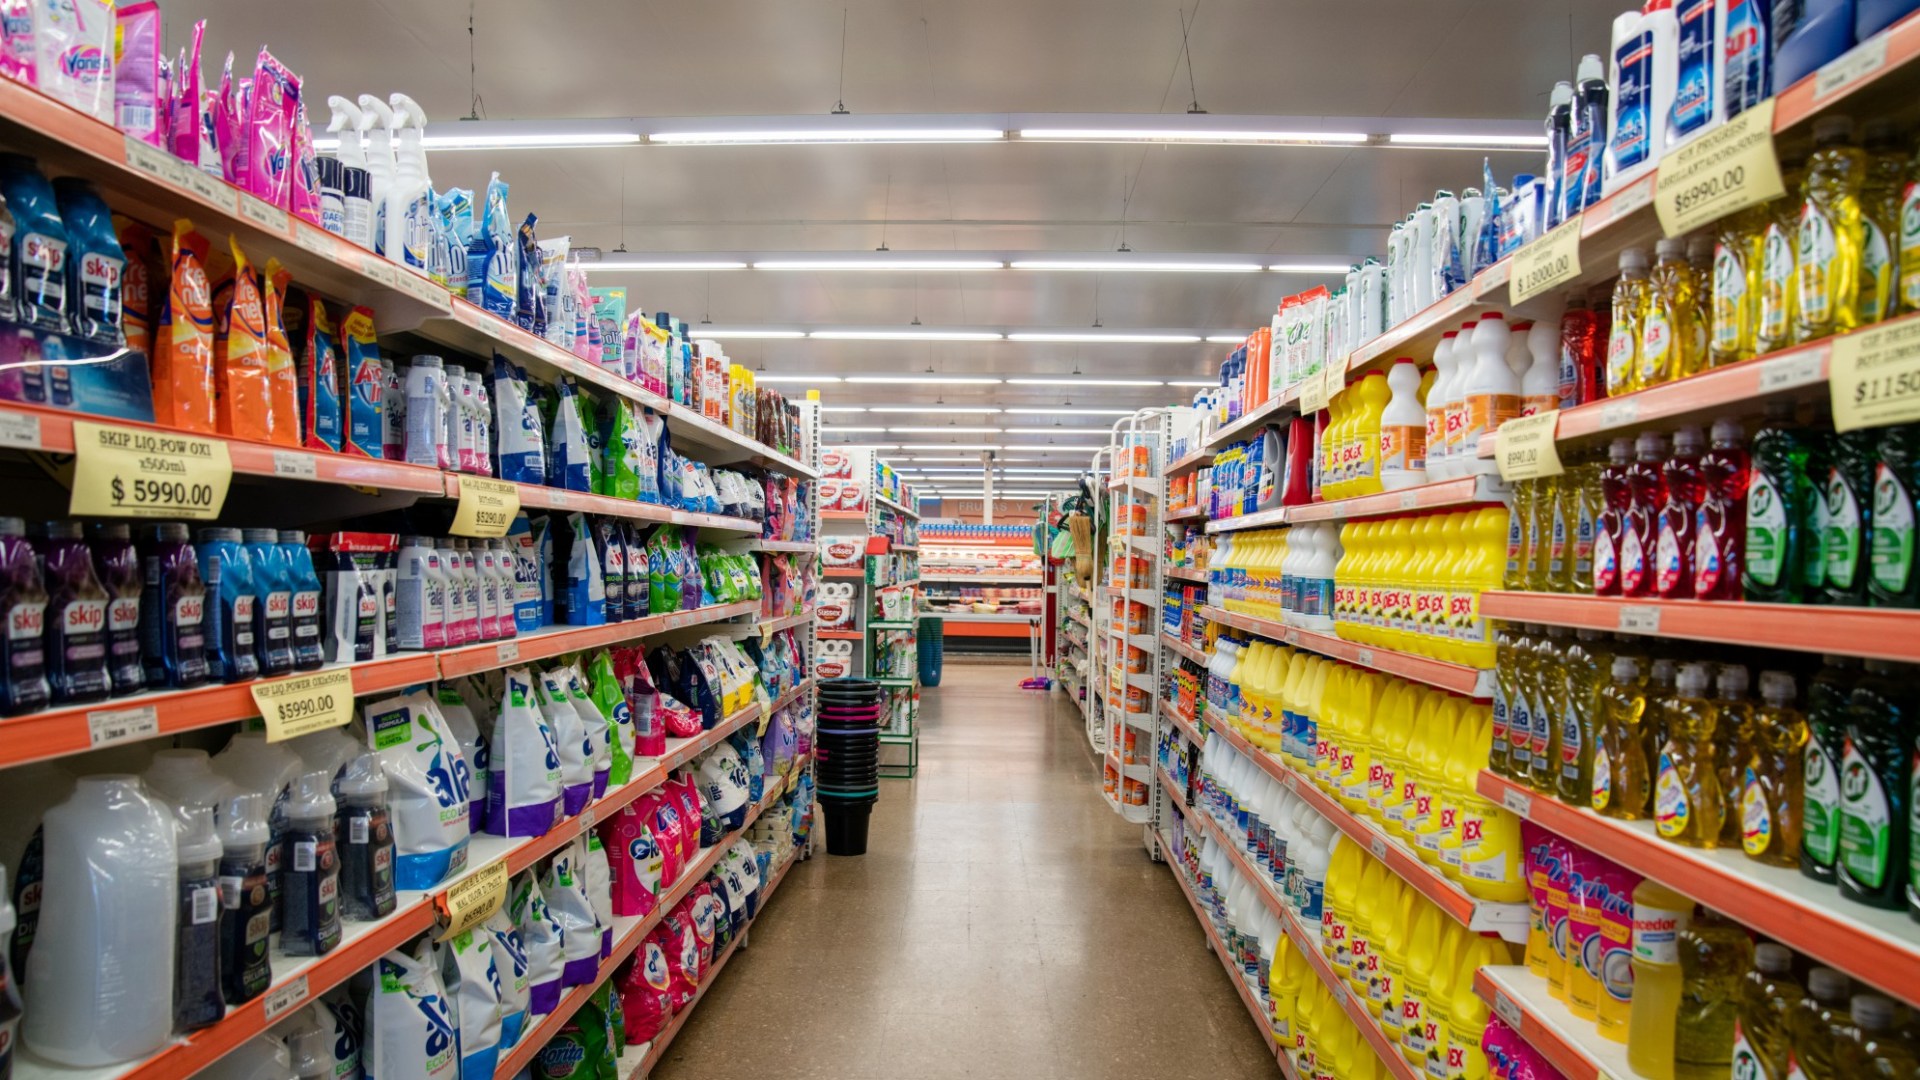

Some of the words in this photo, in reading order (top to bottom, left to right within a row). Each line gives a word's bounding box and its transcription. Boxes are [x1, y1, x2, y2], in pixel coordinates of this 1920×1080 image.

[1675, 166, 1745, 213] $6990.00
[86, 259, 119, 285] skip
[99, 430, 131, 448] SKIP
[134, 435, 187, 453] LIQ.POW
[138, 457, 187, 473] x500ml
[112, 474, 125, 507] $
[134, 479, 212, 506] 5990.00
[959, 502, 1008, 512] FRUAS
[1016, 502, 1024, 512] Y
[476, 510, 507, 526] $5290.00
[829, 546, 855, 556] Sussex
[181, 600, 201, 621] skip
[269, 595, 287, 614] skip
[296, 592, 316, 613] skip
[14, 609, 42, 634] skip
[69, 603, 102, 628] skip
[114, 601, 137, 625] skip
[817, 608, 842, 617] Sussex
[817, 667, 843, 676] Sussex
[278, 694, 335, 721] $5990.00
[377, 718, 405, 731] FORMULA
[440, 808, 457, 822] ECO
[1634, 917, 1677, 931] ncedor
[426, 1055, 446, 1072] ECO
